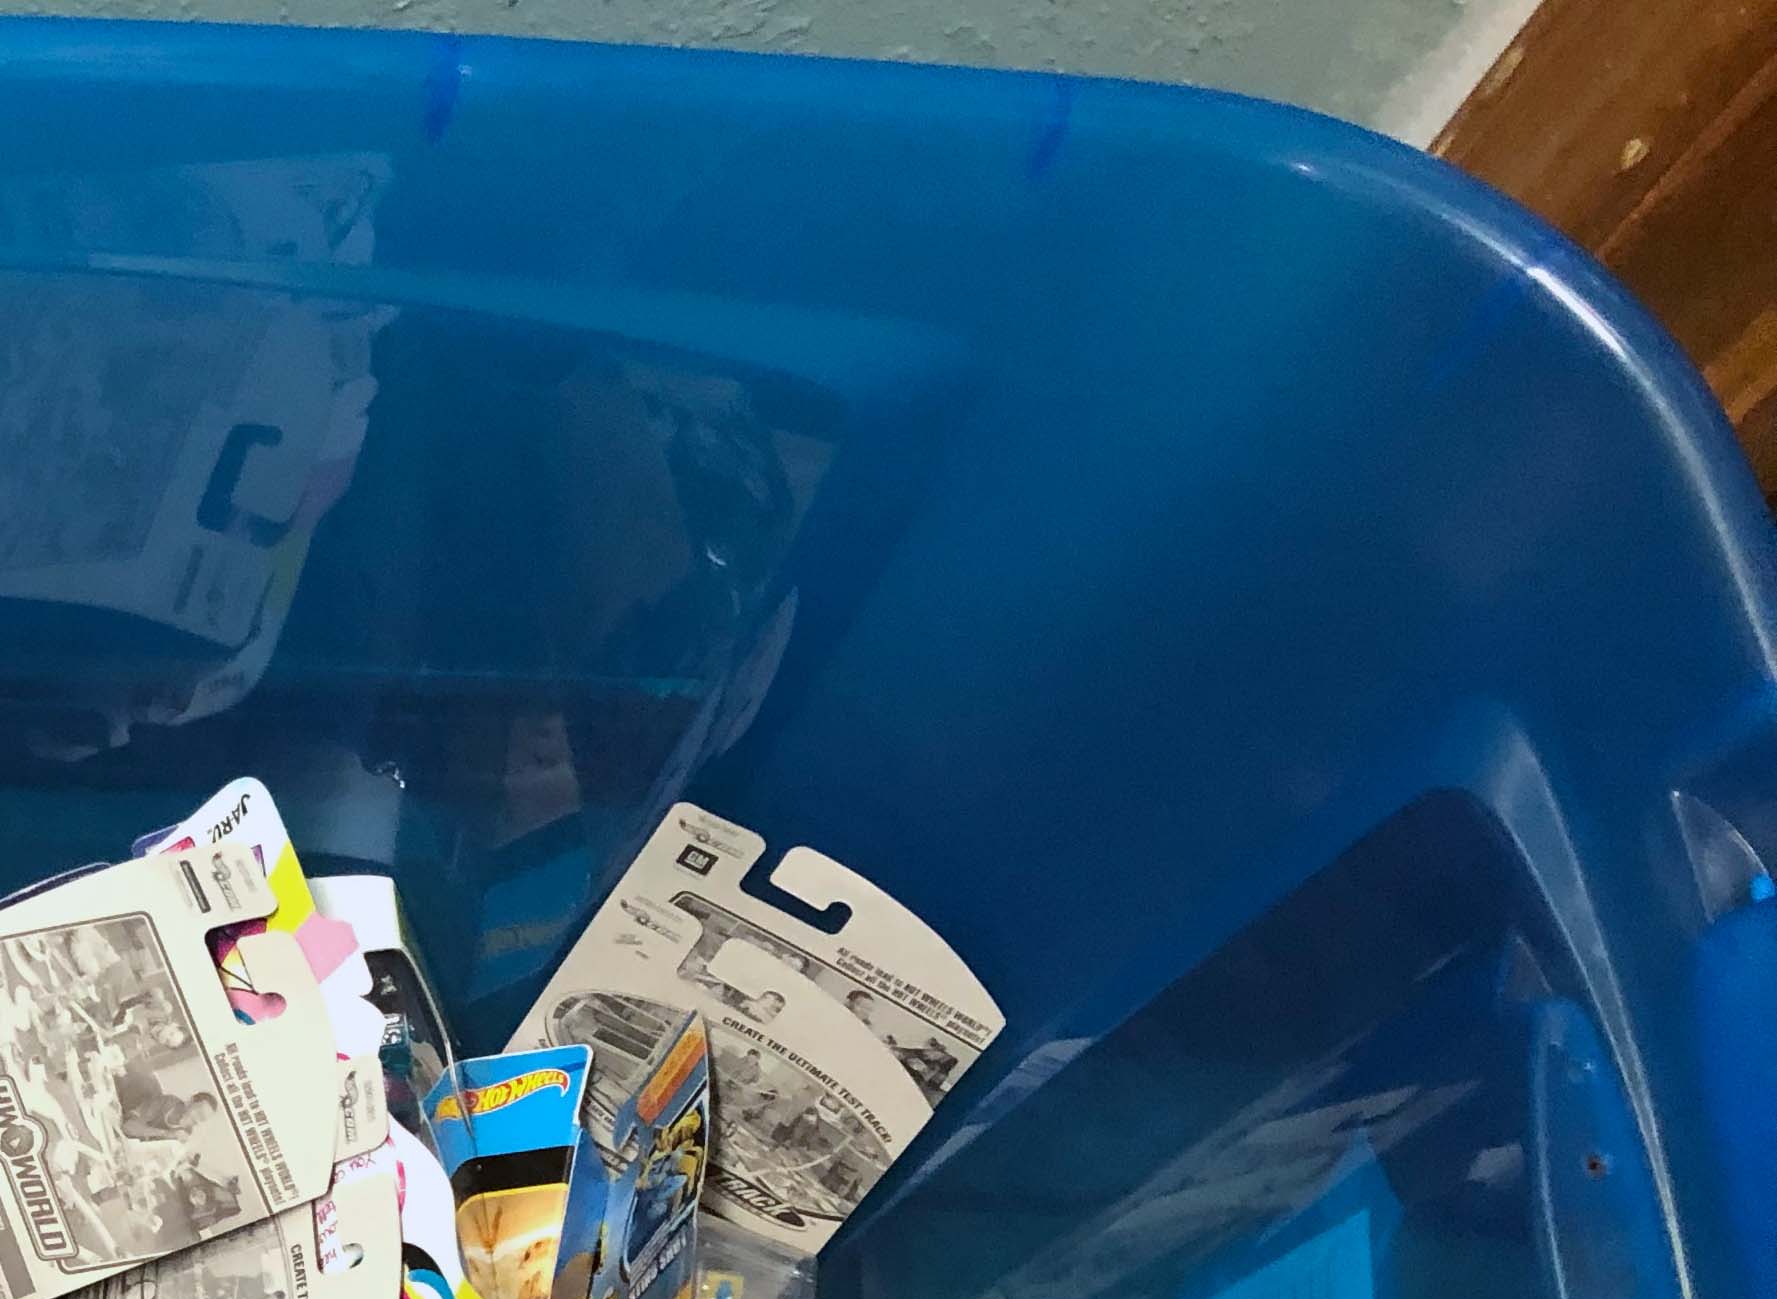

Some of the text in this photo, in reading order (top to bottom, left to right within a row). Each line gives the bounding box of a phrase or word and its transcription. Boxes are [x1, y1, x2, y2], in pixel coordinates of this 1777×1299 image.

[477, 1069, 563, 1111] HOT WHEELS
[722, 1016, 892, 1144] CREATE THE ULTIMATE TEST TRACK!
[9, 1152, 68, 1253] WORLD
[290, 1243, 305, 1289] CREATE
